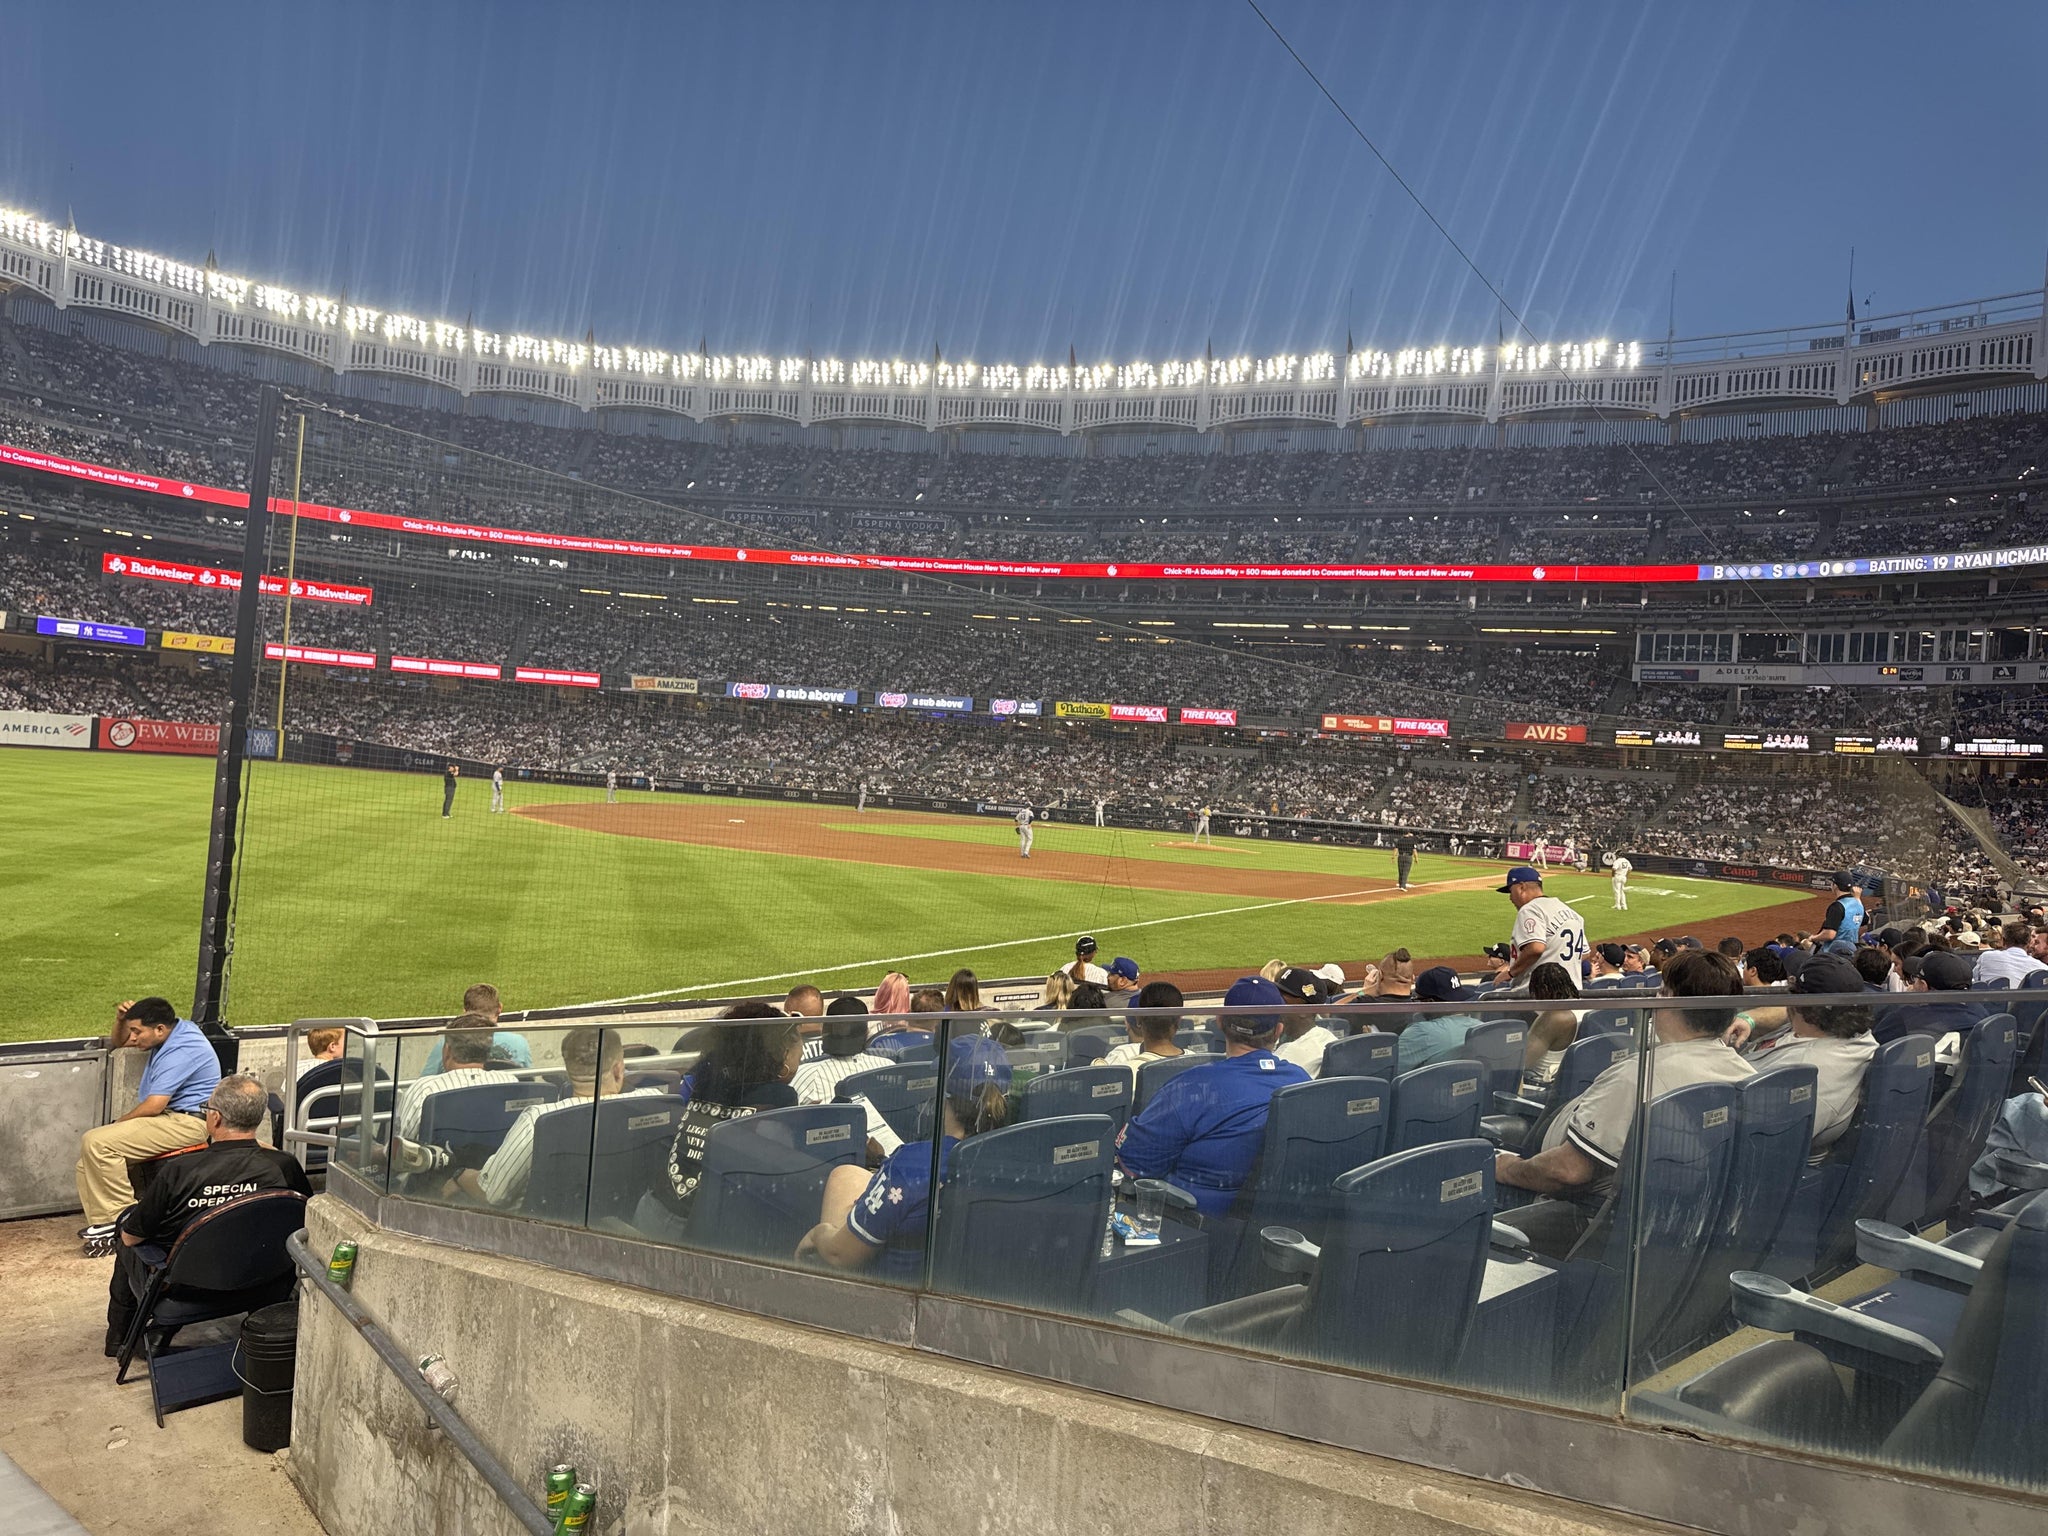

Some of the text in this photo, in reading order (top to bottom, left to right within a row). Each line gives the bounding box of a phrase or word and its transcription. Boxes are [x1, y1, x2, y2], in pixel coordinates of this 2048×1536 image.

[3, 450, 159, 490] to Covenant House New York and New Jersey
[777, 516, 811, 524] VODKA
[857, 520, 940, 530] ASPEN VODKA
[403, 520, 441, 532] Chick-fil-A
[442, 526, 468, 535] Double
[468, 528, 482, 538] Play
[489, 530, 503, 539] 500
[504, 532, 523, 541] meals
[524, 533, 552, 544] donated
[553, 538, 561, 546] to
[562, 538, 593, 548] Covenant
[593, 541, 613, 550] House
[614, 543, 629, 552] New
[629, 544, 644, 553] York
[645, 545, 657, 553] and
[658, 546, 672, 555] New
[672, 548, 692, 557] Jersey
[791, 554, 825, 563] Chick-fil-A
[825, 555, 847, 564] Double
[848, 557, 860, 566] Play
[899, 560, 924, 568] donated
[933, 562, 963, 570] Covenant
[964, 563, 983, 571] House
[984, 564, 998, 572] New
[999, 565, 1013, 573] York
[1027, 566, 1040, 574] New
[1041, 567, 1062, 576] Jersey
[1773, 563, 1783, 578] S
[1870, 558, 1928, 573] BATTING:
[1933, 556, 1949, 570] 19
[1954, 553, 1992, 568] RYAN
[131, 561, 195, 581] Budweiser
[1163, 567, 1199, 575] Chick-fil-A
[1225, 568, 1239, 577] Play
[1246, 568, 1260, 576] 500
[1261, 568, 1281, 576] meals
[1282, 568, 1311, 576] donated
[1321, 568, 1355, 576] Covenant
[1356, 569, 1379, 577] House
[1380, 569, 1397, 577] New
[1398, 569, 1414, 577] York
[1415, 569, 1429, 577] and
[1431, 569, 1448, 577] New
[1449, 570, 1474, 579] Jersey
[1714, 565, 1724, 580] B
[308, 585, 368, 602] Budweiser
[658, 680, 696, 691] AMAZING
[777, 689, 845, 703] a sub above
[912, 698, 963, 709] a sub above
[1061, 703, 1105, 717] Nathan's
[1112, 705, 1167, 722] TIRE RACK
[1183, 710, 1236, 726] TIRE RACK
[3, 723, 61, 735] AMERICA
[137, 724, 220, 743] F.W. WEB
[1395, 720, 1448, 735] TIRE RACK
[1523, 725, 1568, 741] AVIS
[1967, 744, 1978, 752] THE
[1979, 744, 2006, 753] YANKEES
[2007, 745, 2021, 753] LIVE
[1722, 866, 1758, 878] Canon
[1772, 870, 1804, 882] Canon
[1559, 928, 1584, 962] 34
[1450, 975, 1461, 990] NY
[984, 1060, 995, 1076] LA
[864, 1171, 887, 1215] LA
